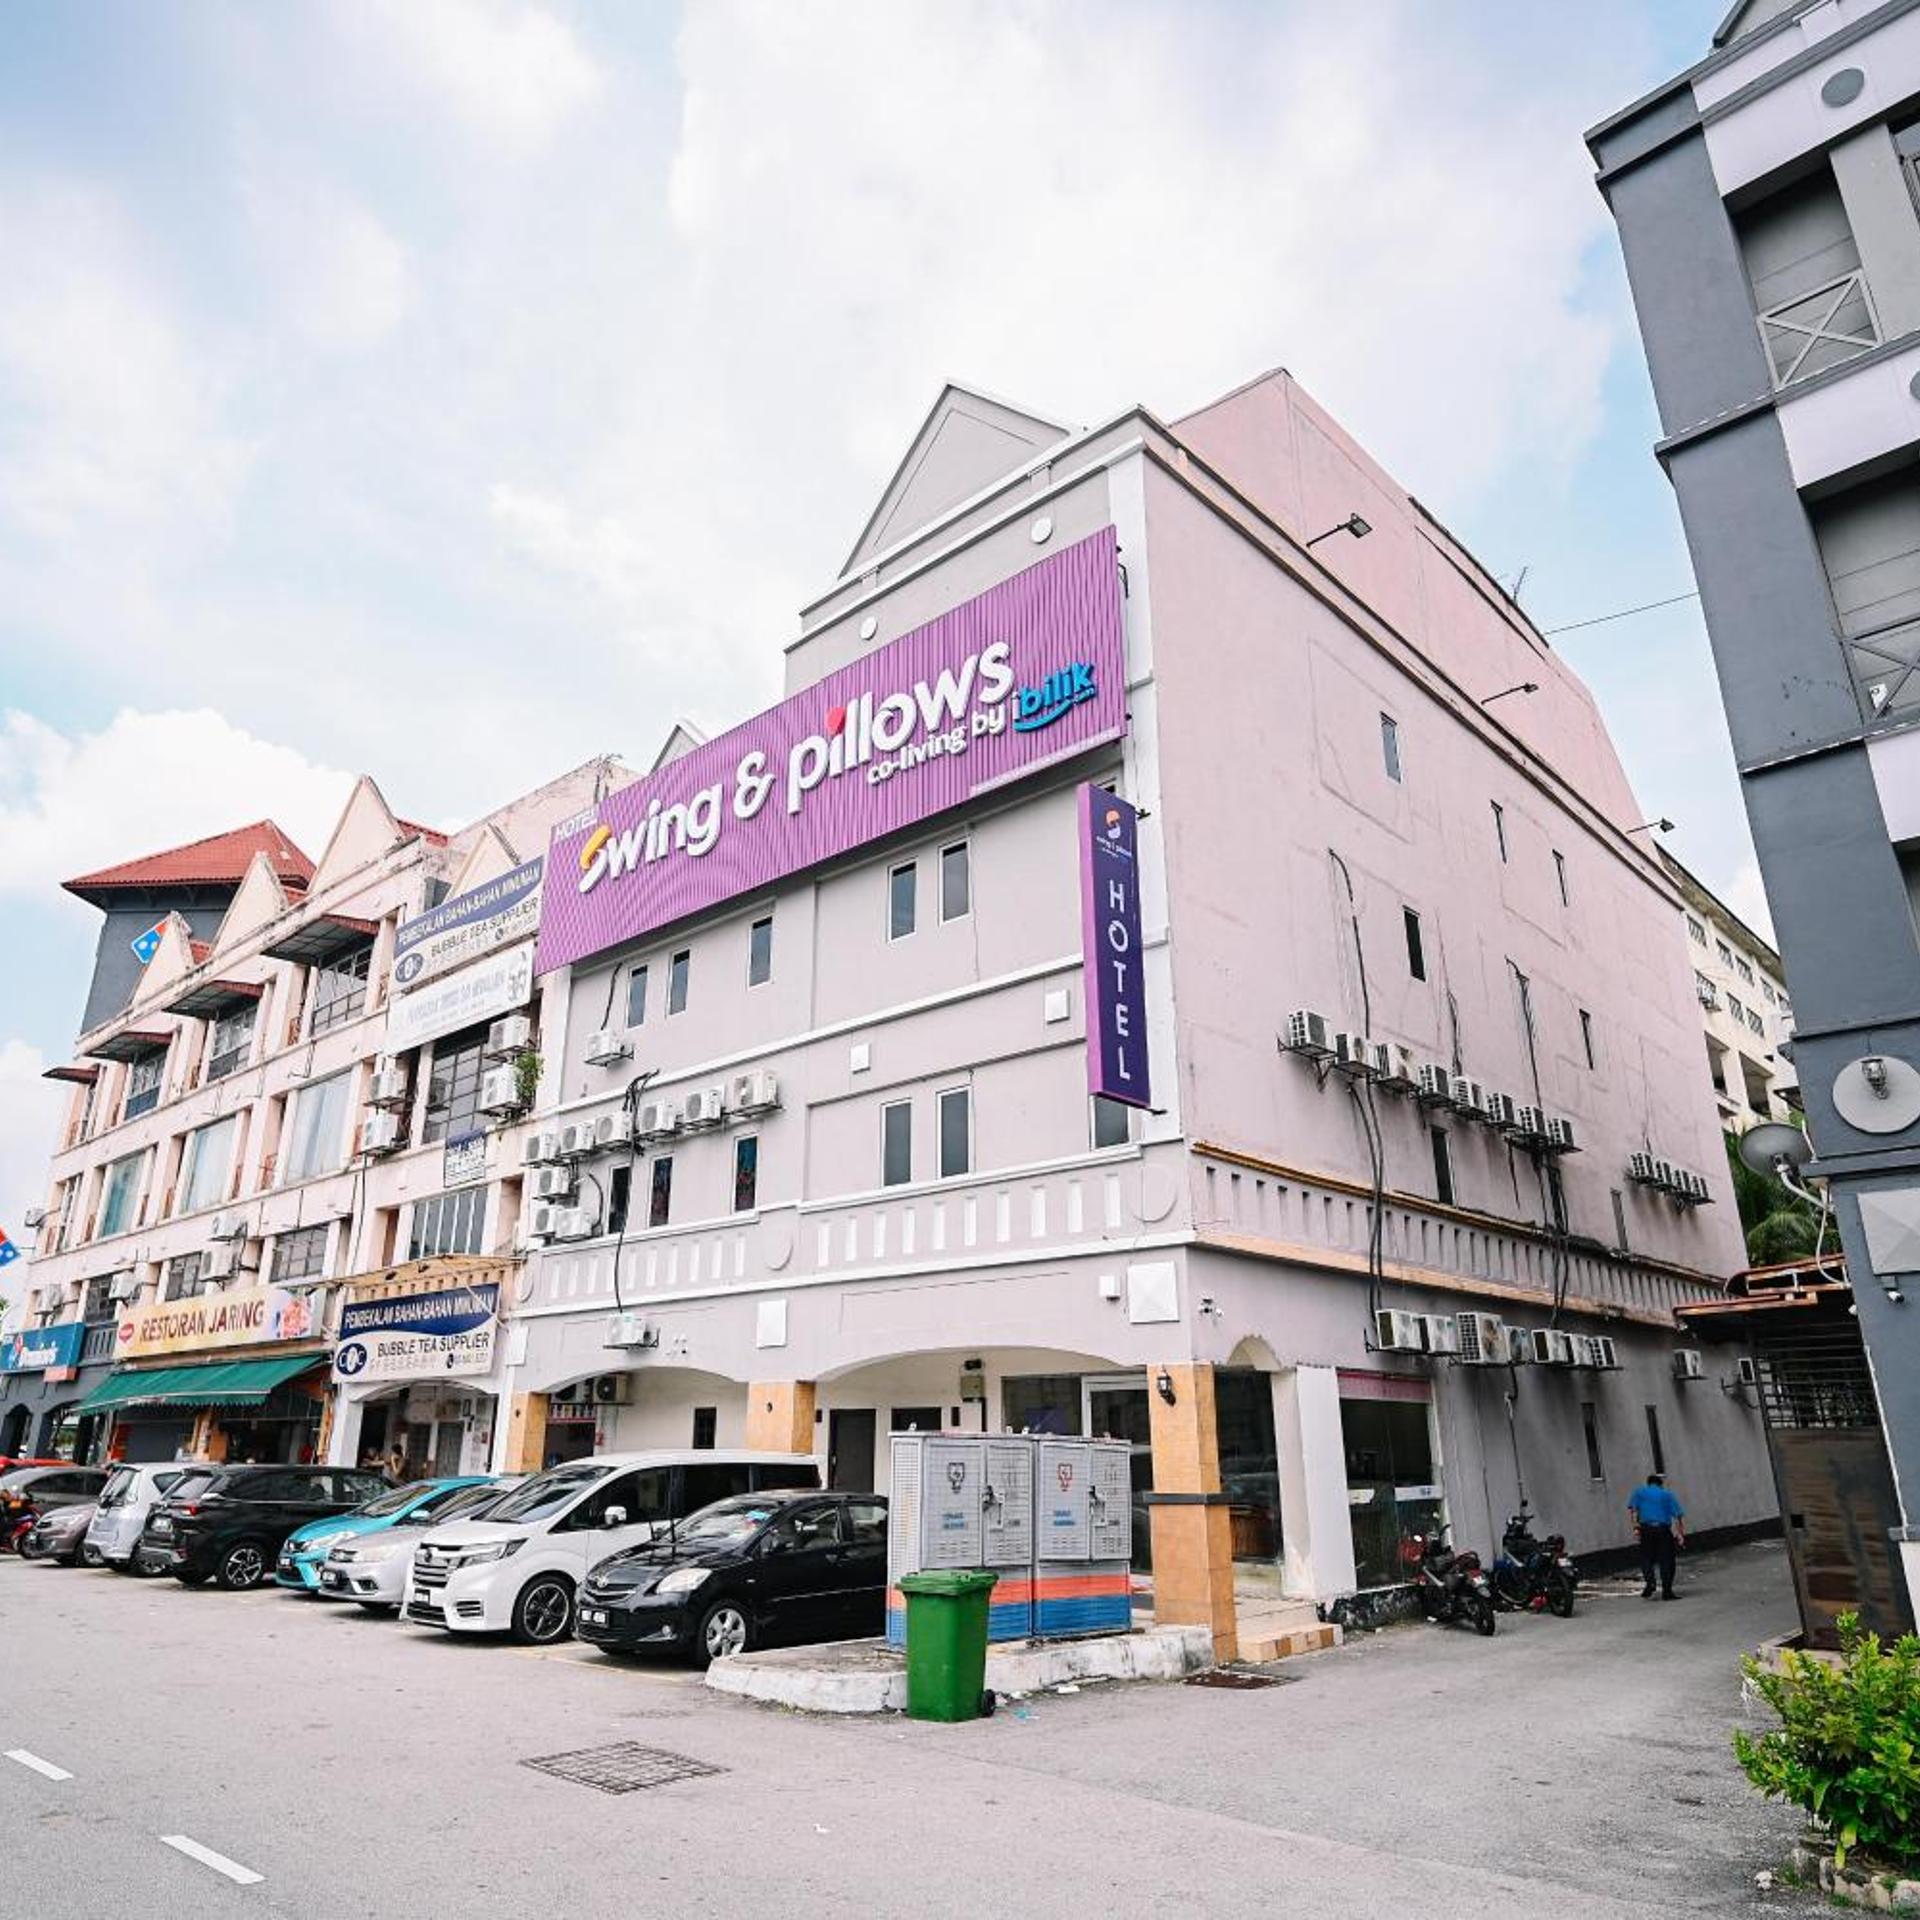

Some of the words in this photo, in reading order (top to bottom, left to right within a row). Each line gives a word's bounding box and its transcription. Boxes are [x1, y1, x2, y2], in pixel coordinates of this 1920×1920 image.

[732, 750, 775, 820] &
[787, 641, 1014, 815] pillows
[867, 725, 969, 786] co-living
[971, 701, 1007, 738] by
[1012, 662, 1095, 721] ibilik
[470, 921, 488, 940] TEA
[490, 896, 538, 929] SUPPLIER
[1108, 879, 1131, 1081] HOTEL
[139, 1310, 205, 1342] RESTORAN
[209, 1300, 264, 1333] JARING
[377, 1339, 416, 1357] BUBBLE
[418, 1337, 437, 1353] TEA
[439, 1331, 490, 1352] SUPPLIER
